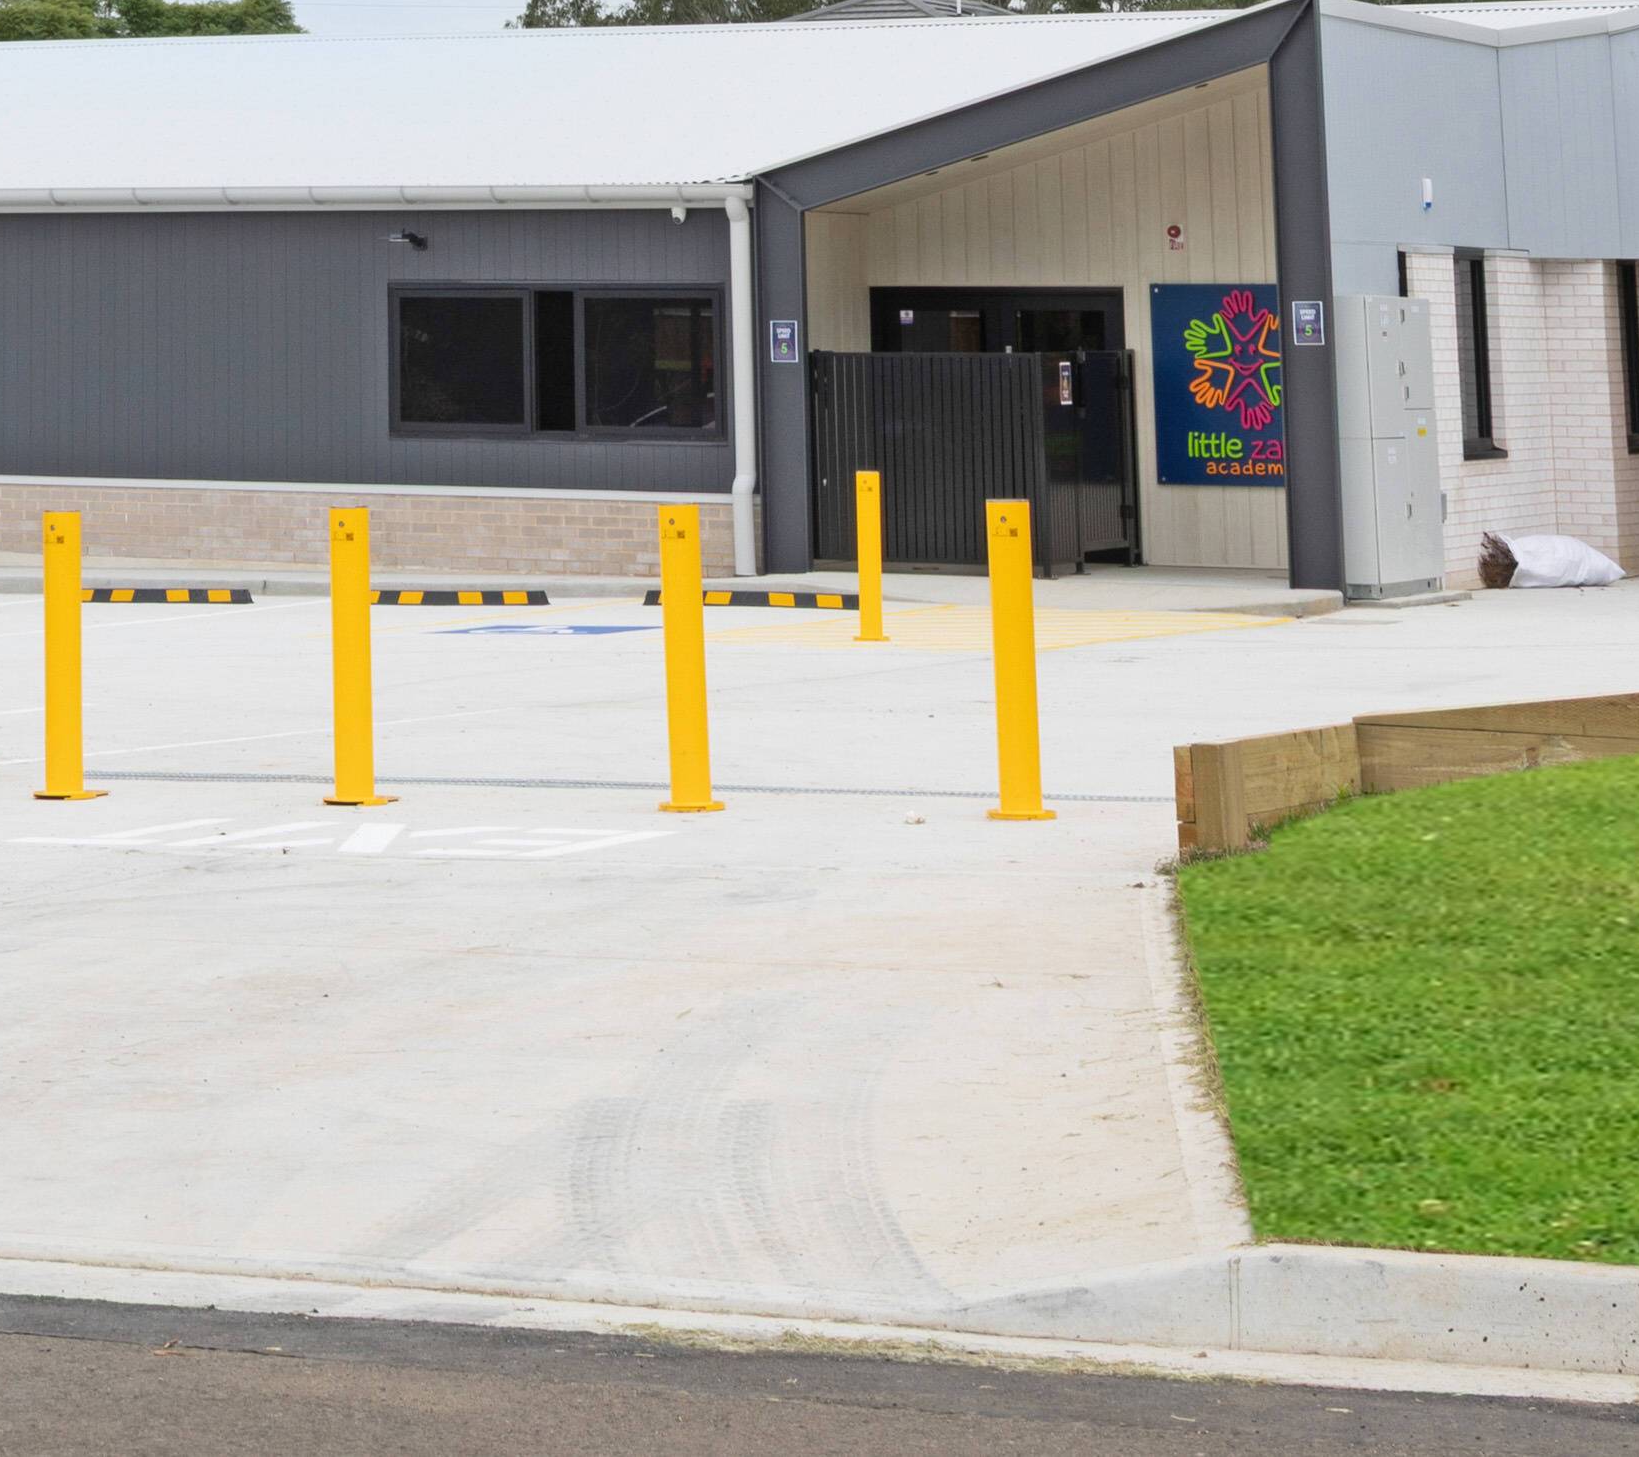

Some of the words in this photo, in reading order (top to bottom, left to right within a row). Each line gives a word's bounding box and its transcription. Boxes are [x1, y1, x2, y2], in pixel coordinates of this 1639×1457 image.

[1305, 324, 1313, 336] 5
[781, 342, 788, 354] 5
[1187, 431, 1243, 458] little
[1206, 459, 1283, 475] academ
